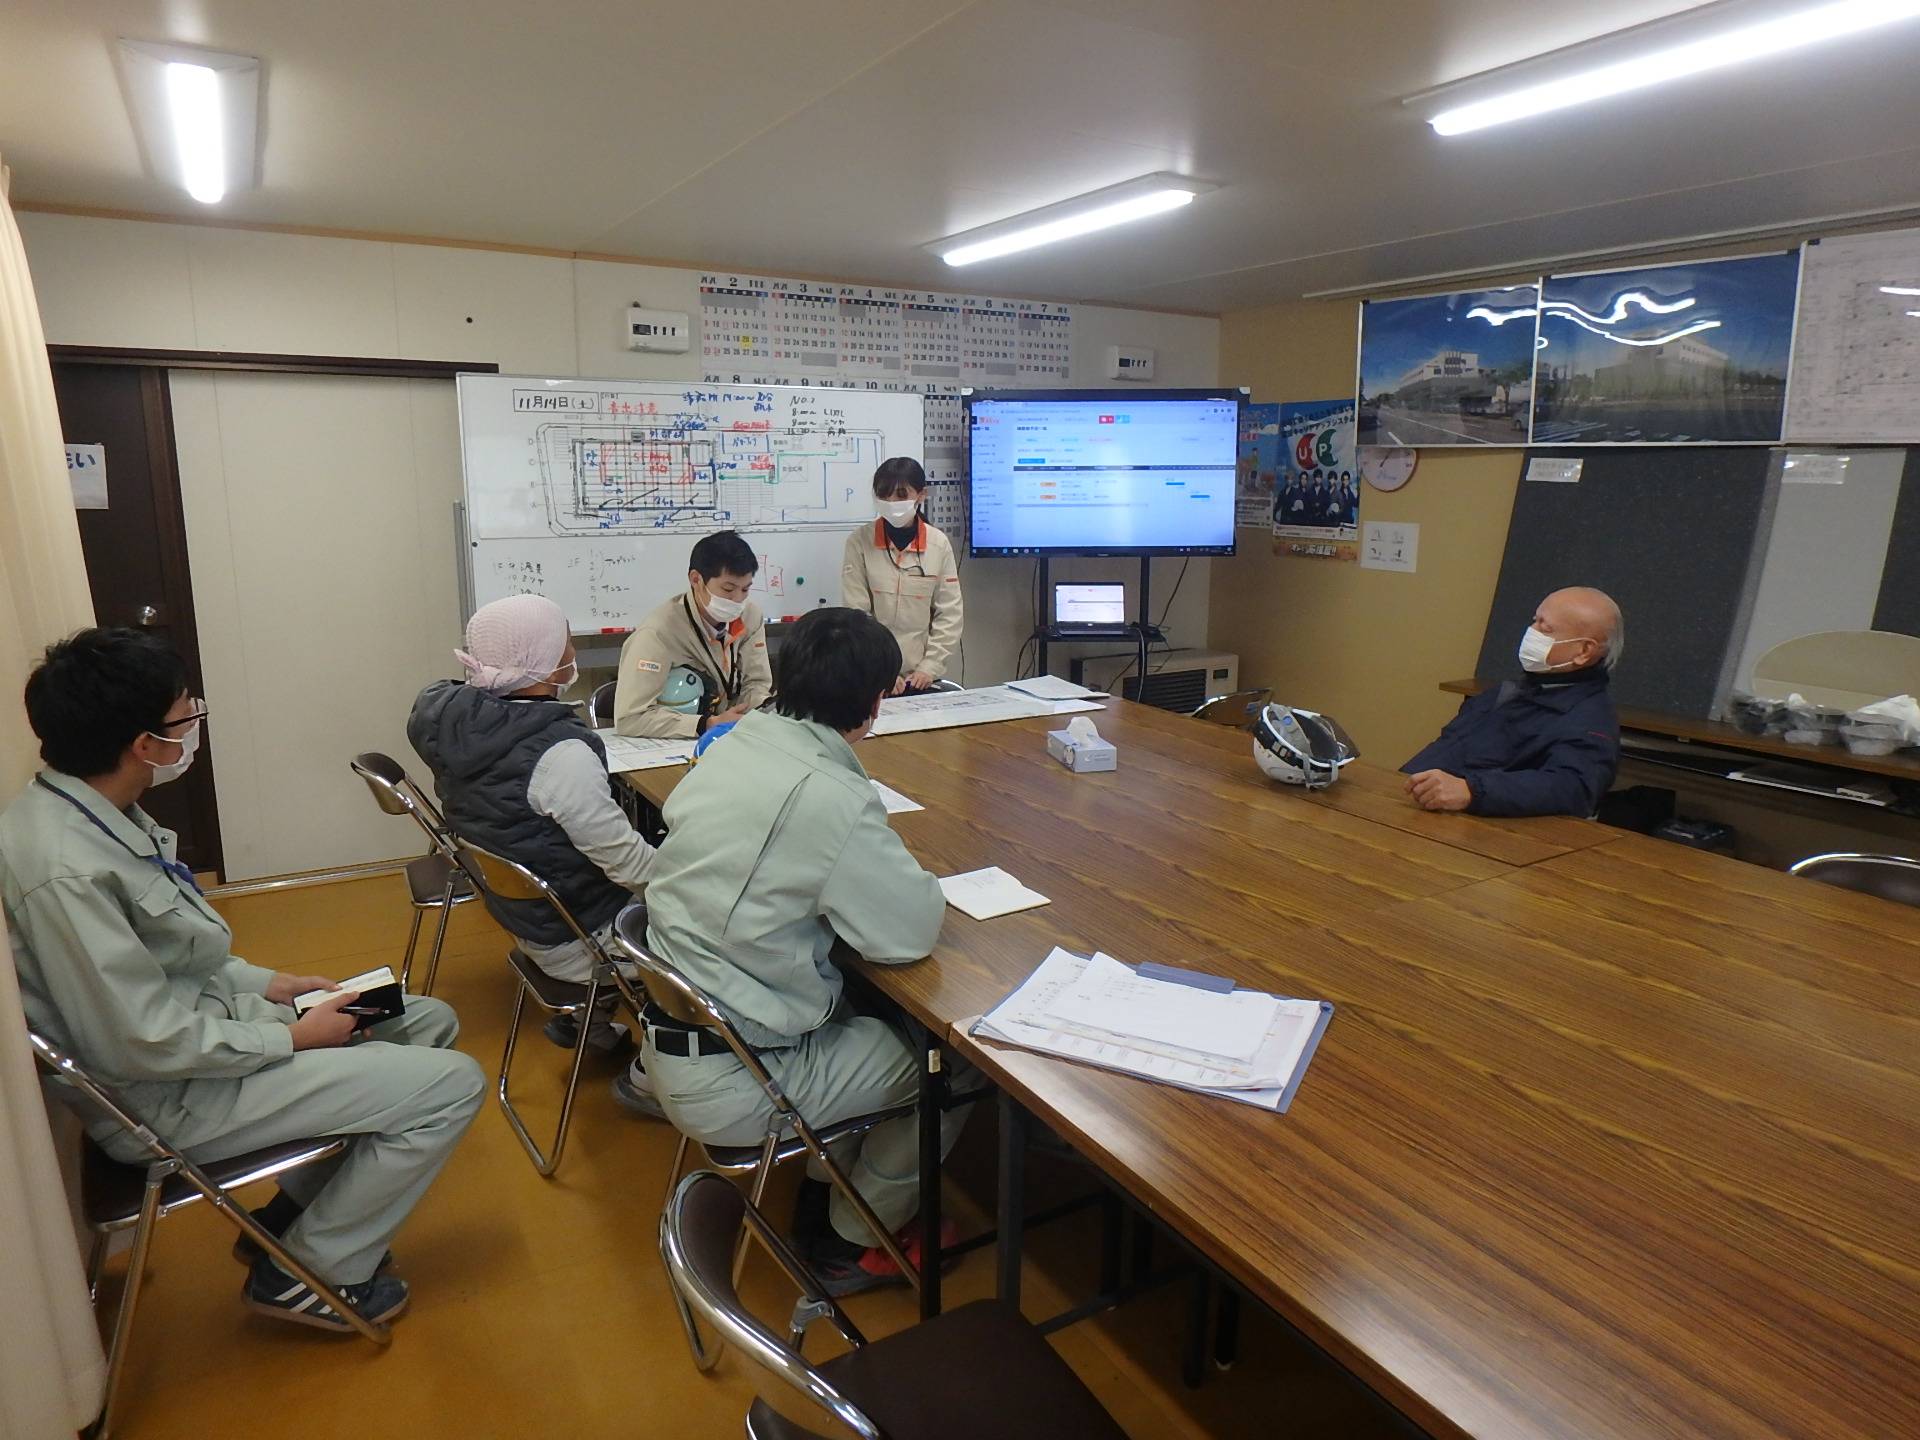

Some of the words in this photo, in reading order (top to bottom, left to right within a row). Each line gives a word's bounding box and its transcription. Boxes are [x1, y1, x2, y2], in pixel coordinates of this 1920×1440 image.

[730, 277, 737, 287] 2
[800, 284, 807, 293] 3
[866, 290, 872, 298] 4
[927, 295, 934, 303] 5
[986, 300, 992, 308] 6
[1041, 304, 1048, 312] 7
[732, 375, 740, 383] 8
[801, 378, 810, 386] 9
[927, 384, 936, 392] 11
[519, 396, 595, 410] 11月14日(土)
[1299, 447, 1307, 459] U
[1319, 443, 1327, 456] P
[929, 470, 935, 479] 4
[846, 488, 853, 502] P
